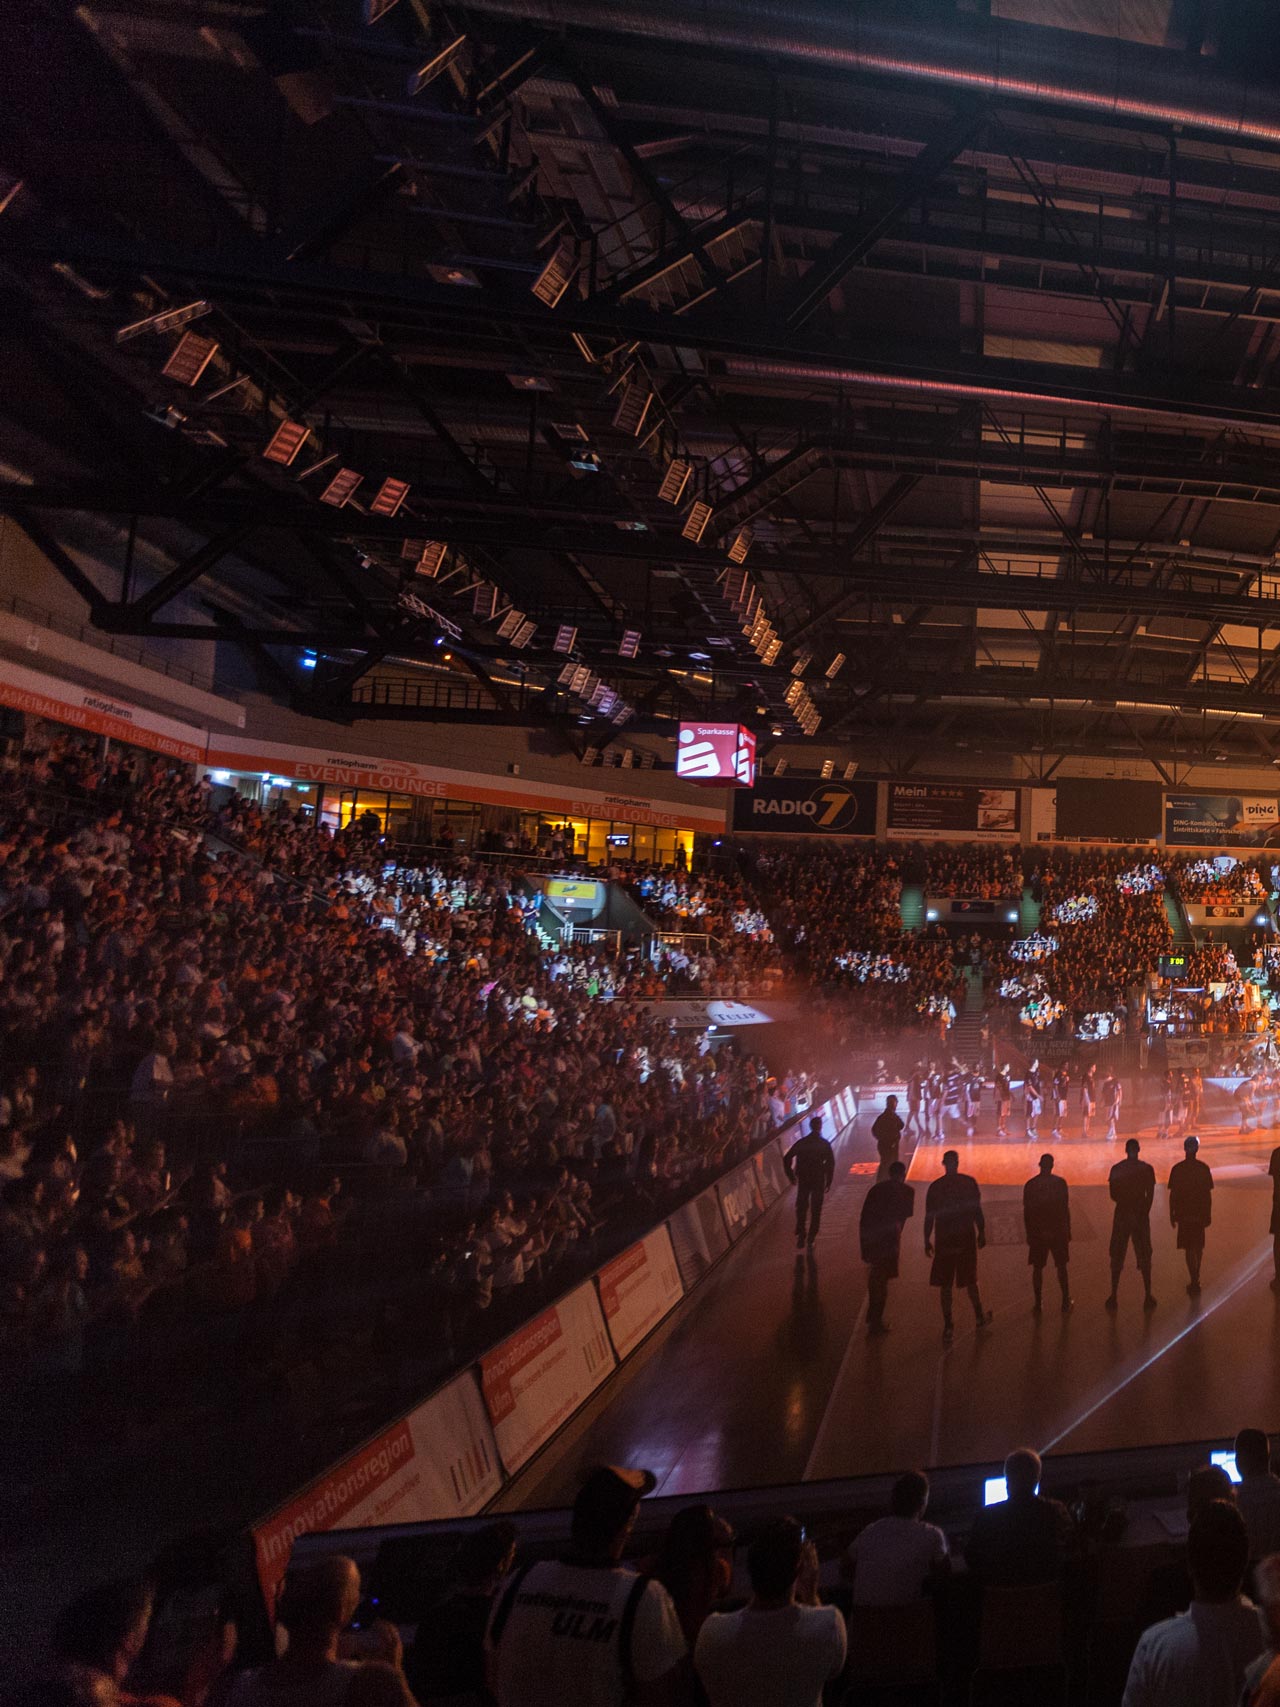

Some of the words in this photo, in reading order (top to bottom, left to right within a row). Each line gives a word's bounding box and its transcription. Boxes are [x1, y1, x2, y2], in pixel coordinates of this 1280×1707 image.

[0, 688, 60, 716] ASKETBALL
[65, 707, 87, 725] ULM
[83, 696, 133, 719] ratiopharm
[697, 727, 735, 736] Sparkasse
[157, 738, 180, 754] MEIN
[181, 745, 201, 761] SPIEL
[327, 757, 378, 770] ratiopharm
[294, 763, 361, 785] EVENT
[368, 774, 449, 796] LOUNGE
[893, 786, 928, 797] Meinl
[605, 795, 651, 807] ratiopharm
[753, 799, 817, 816] RADIO
[818, 792, 853, 825] 7
[1248, 805, 1275, 815] DING
[572, 802, 620, 820] EVENT
[622, 809, 679, 826] LOUNGE
[1173, 819, 1226, 827] DING-Kombiticket:
[1173, 826, 1210, 834] Eintrittskarte
[715, 1013, 756, 1022] TULIP
[263, 1432, 410, 1563] Innovationsregion
[551, 1612, 618, 1642] ULM
